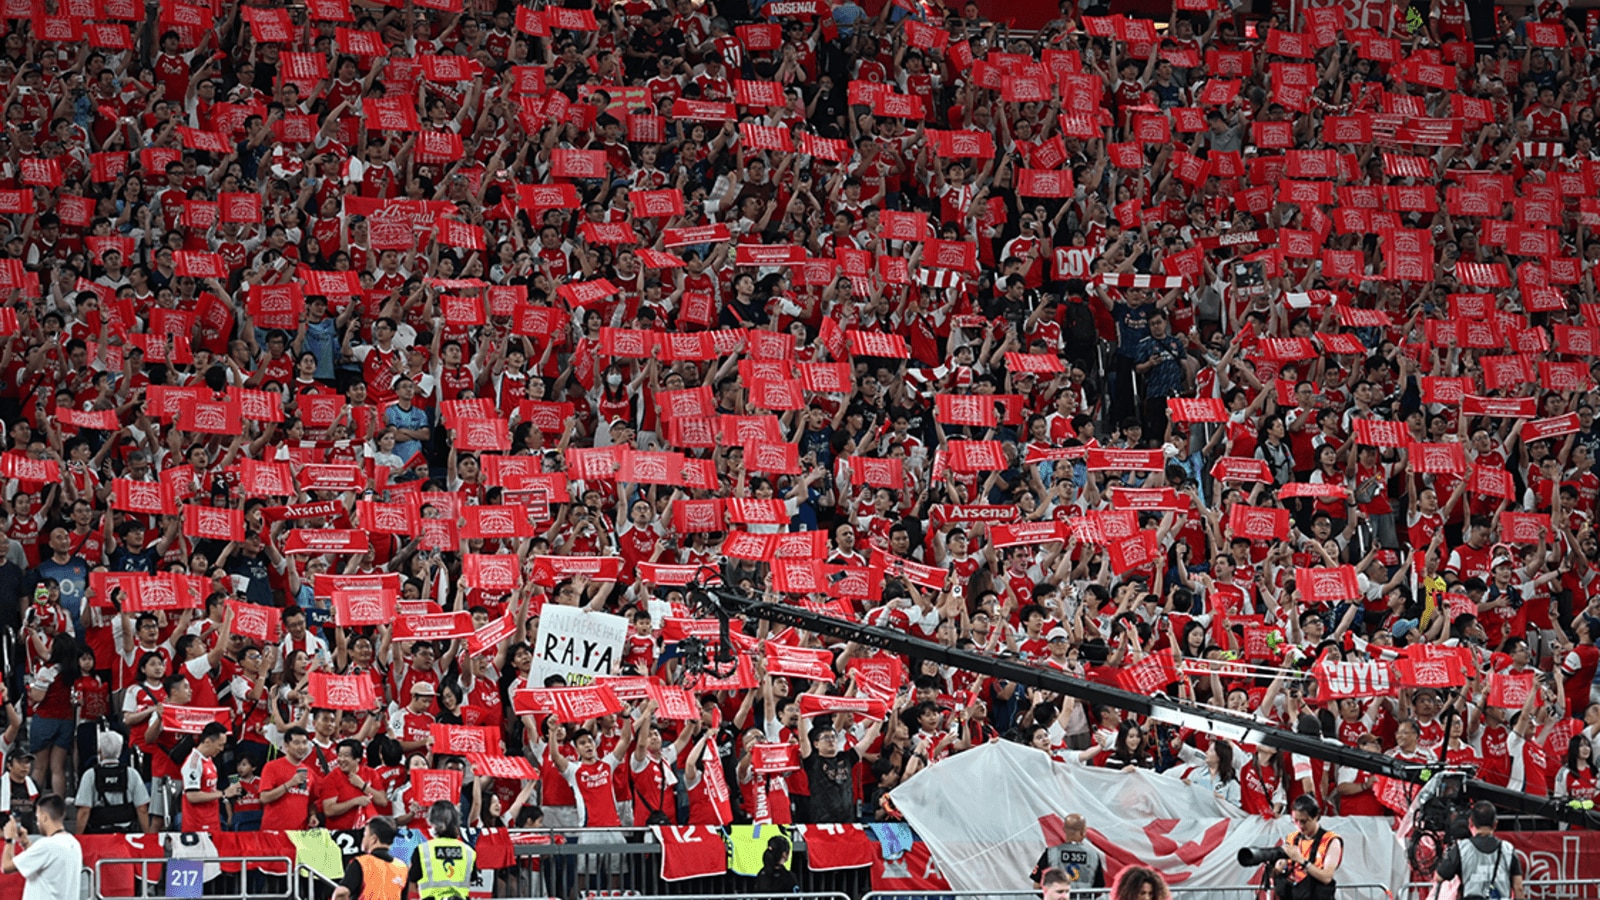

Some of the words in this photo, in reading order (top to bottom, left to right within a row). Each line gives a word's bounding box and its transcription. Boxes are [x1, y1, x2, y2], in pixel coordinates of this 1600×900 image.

[770, 1, 817, 15] ARSENAL
[1219, 231, 1260, 246] ARSENAL
[284, 502, 336, 517] Arsenal
[950, 506, 1015, 518] Arsenal
[543, 632, 613, 675] RAYA
[1322, 659, 1390, 695] COYG
[436, 849, 445, 857] A
[1061, 852, 1070, 861] D
[1071, 852, 1086, 862] 357
[171, 869, 198, 887] 217
